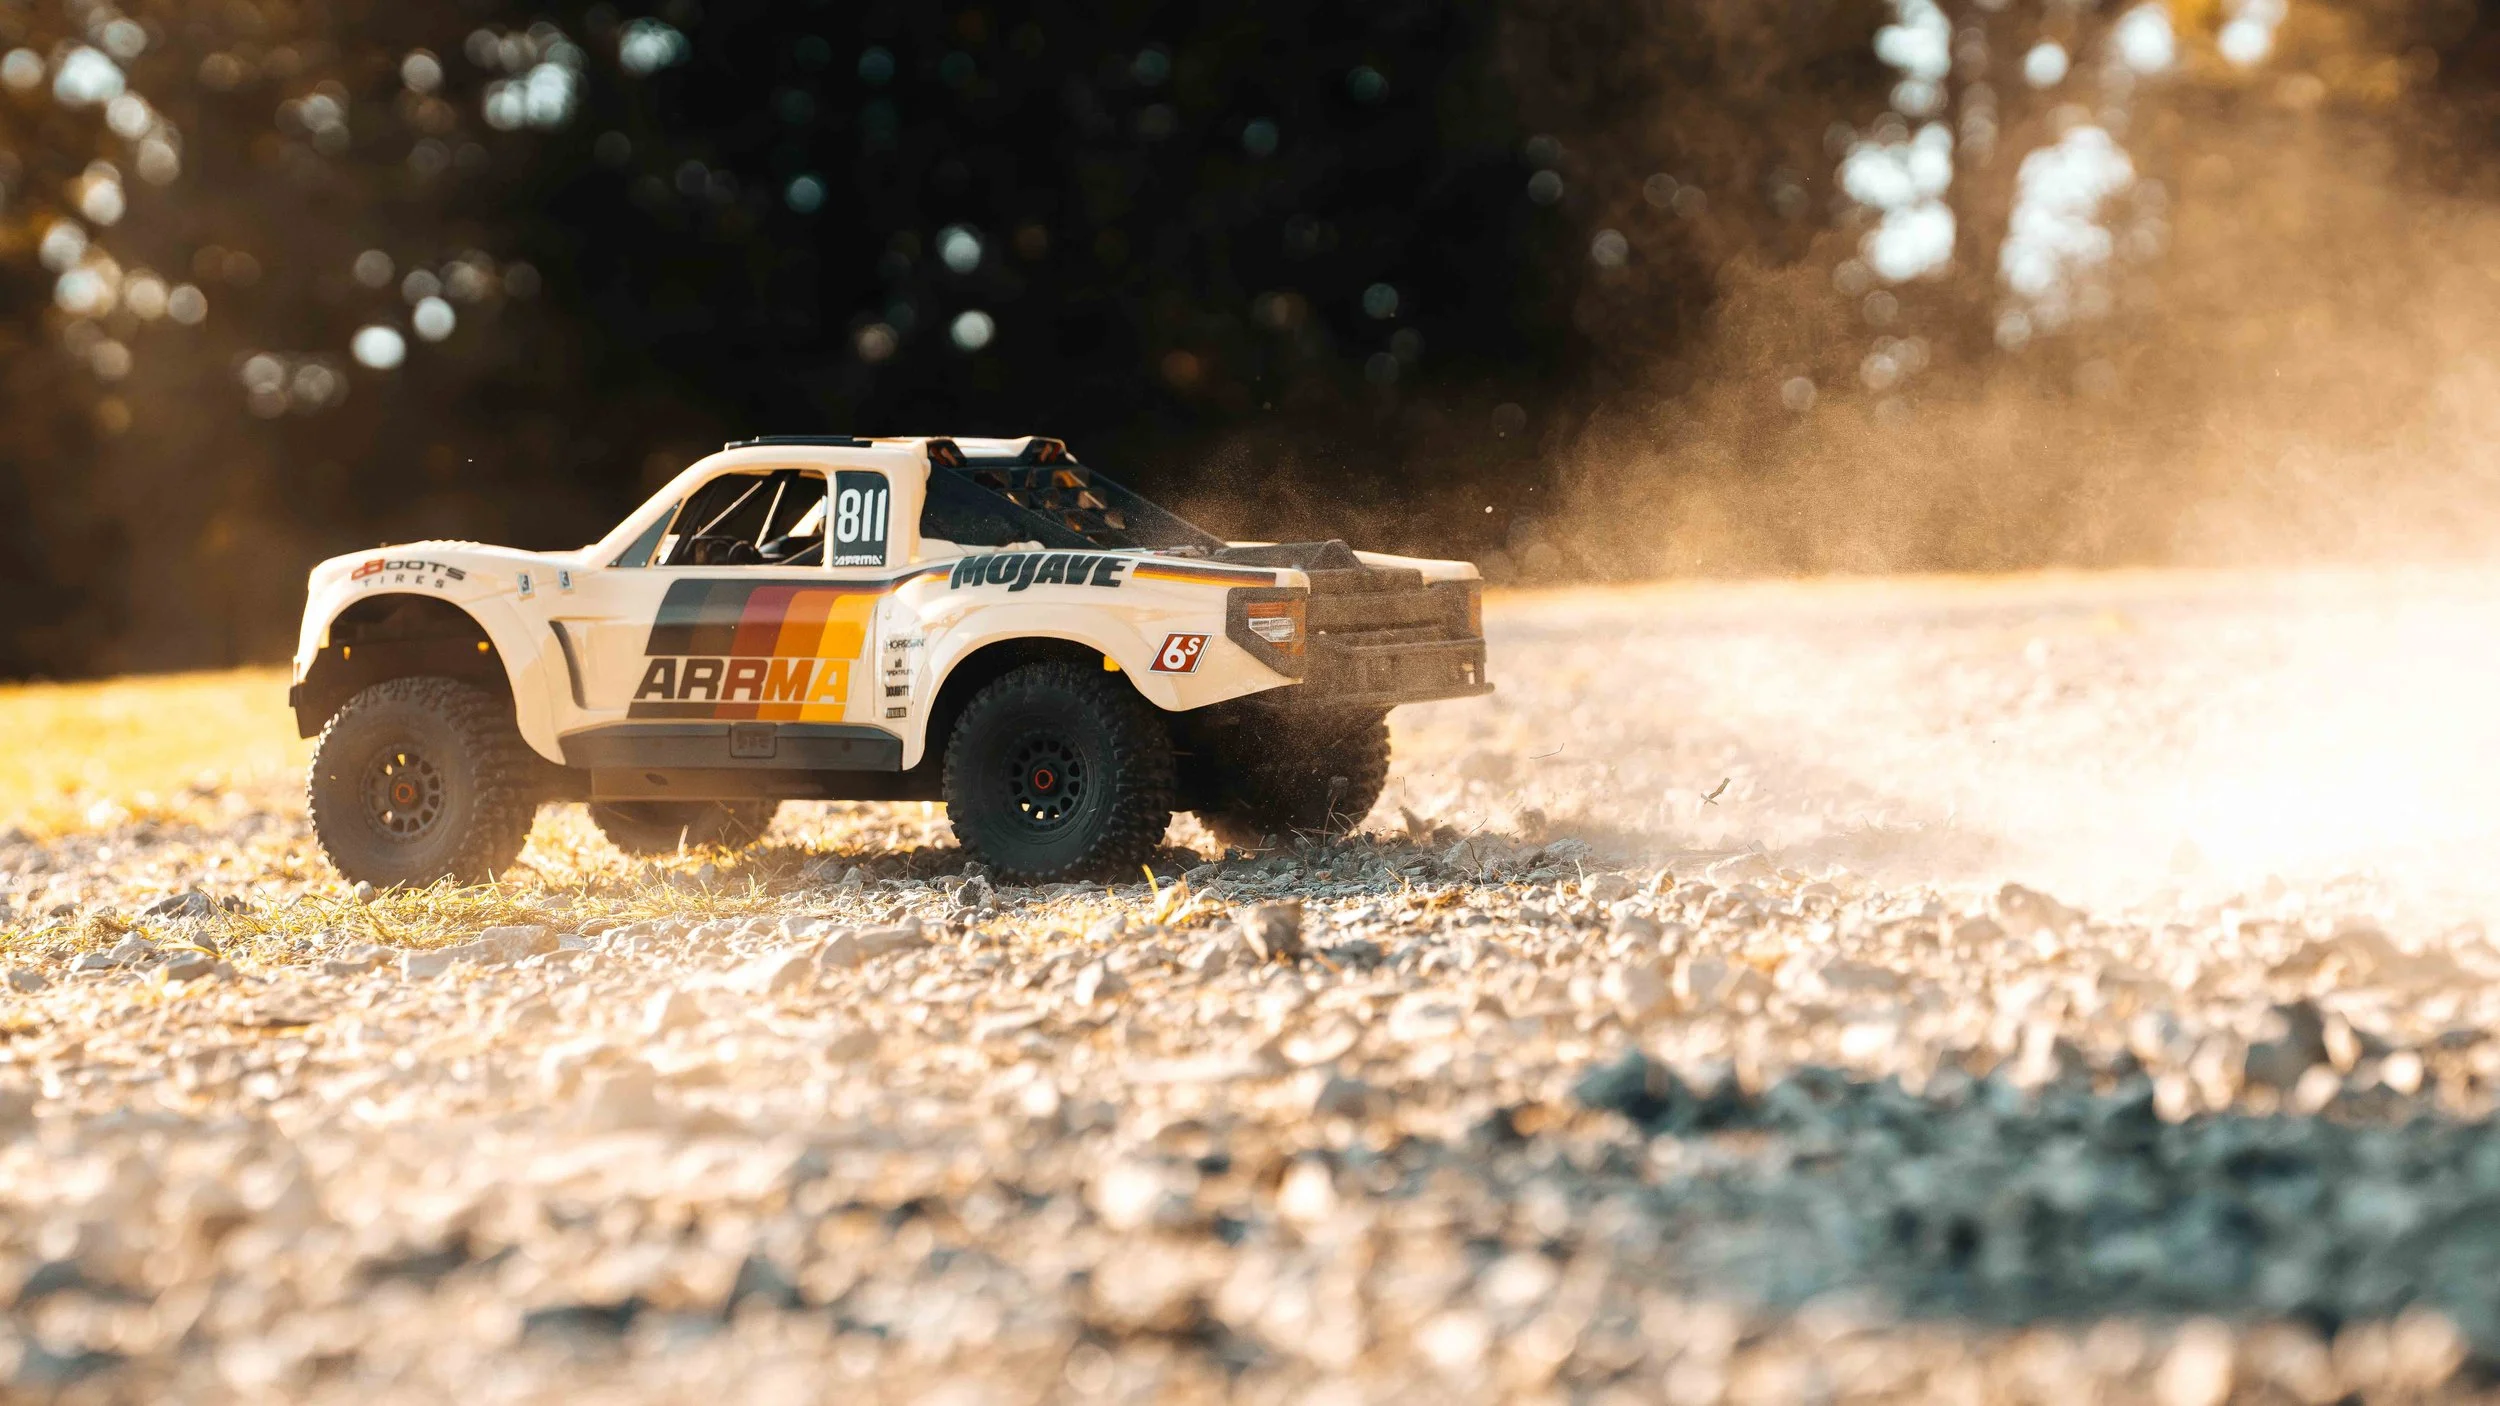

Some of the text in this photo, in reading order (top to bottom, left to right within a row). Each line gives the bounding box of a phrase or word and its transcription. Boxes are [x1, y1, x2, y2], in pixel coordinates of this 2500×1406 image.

[837, 488, 888, 543] 811
[362, 573, 446, 589] TIRES
[950, 553, 1132, 592] MOJAVE
[633, 658, 850, 703] ARRMA
